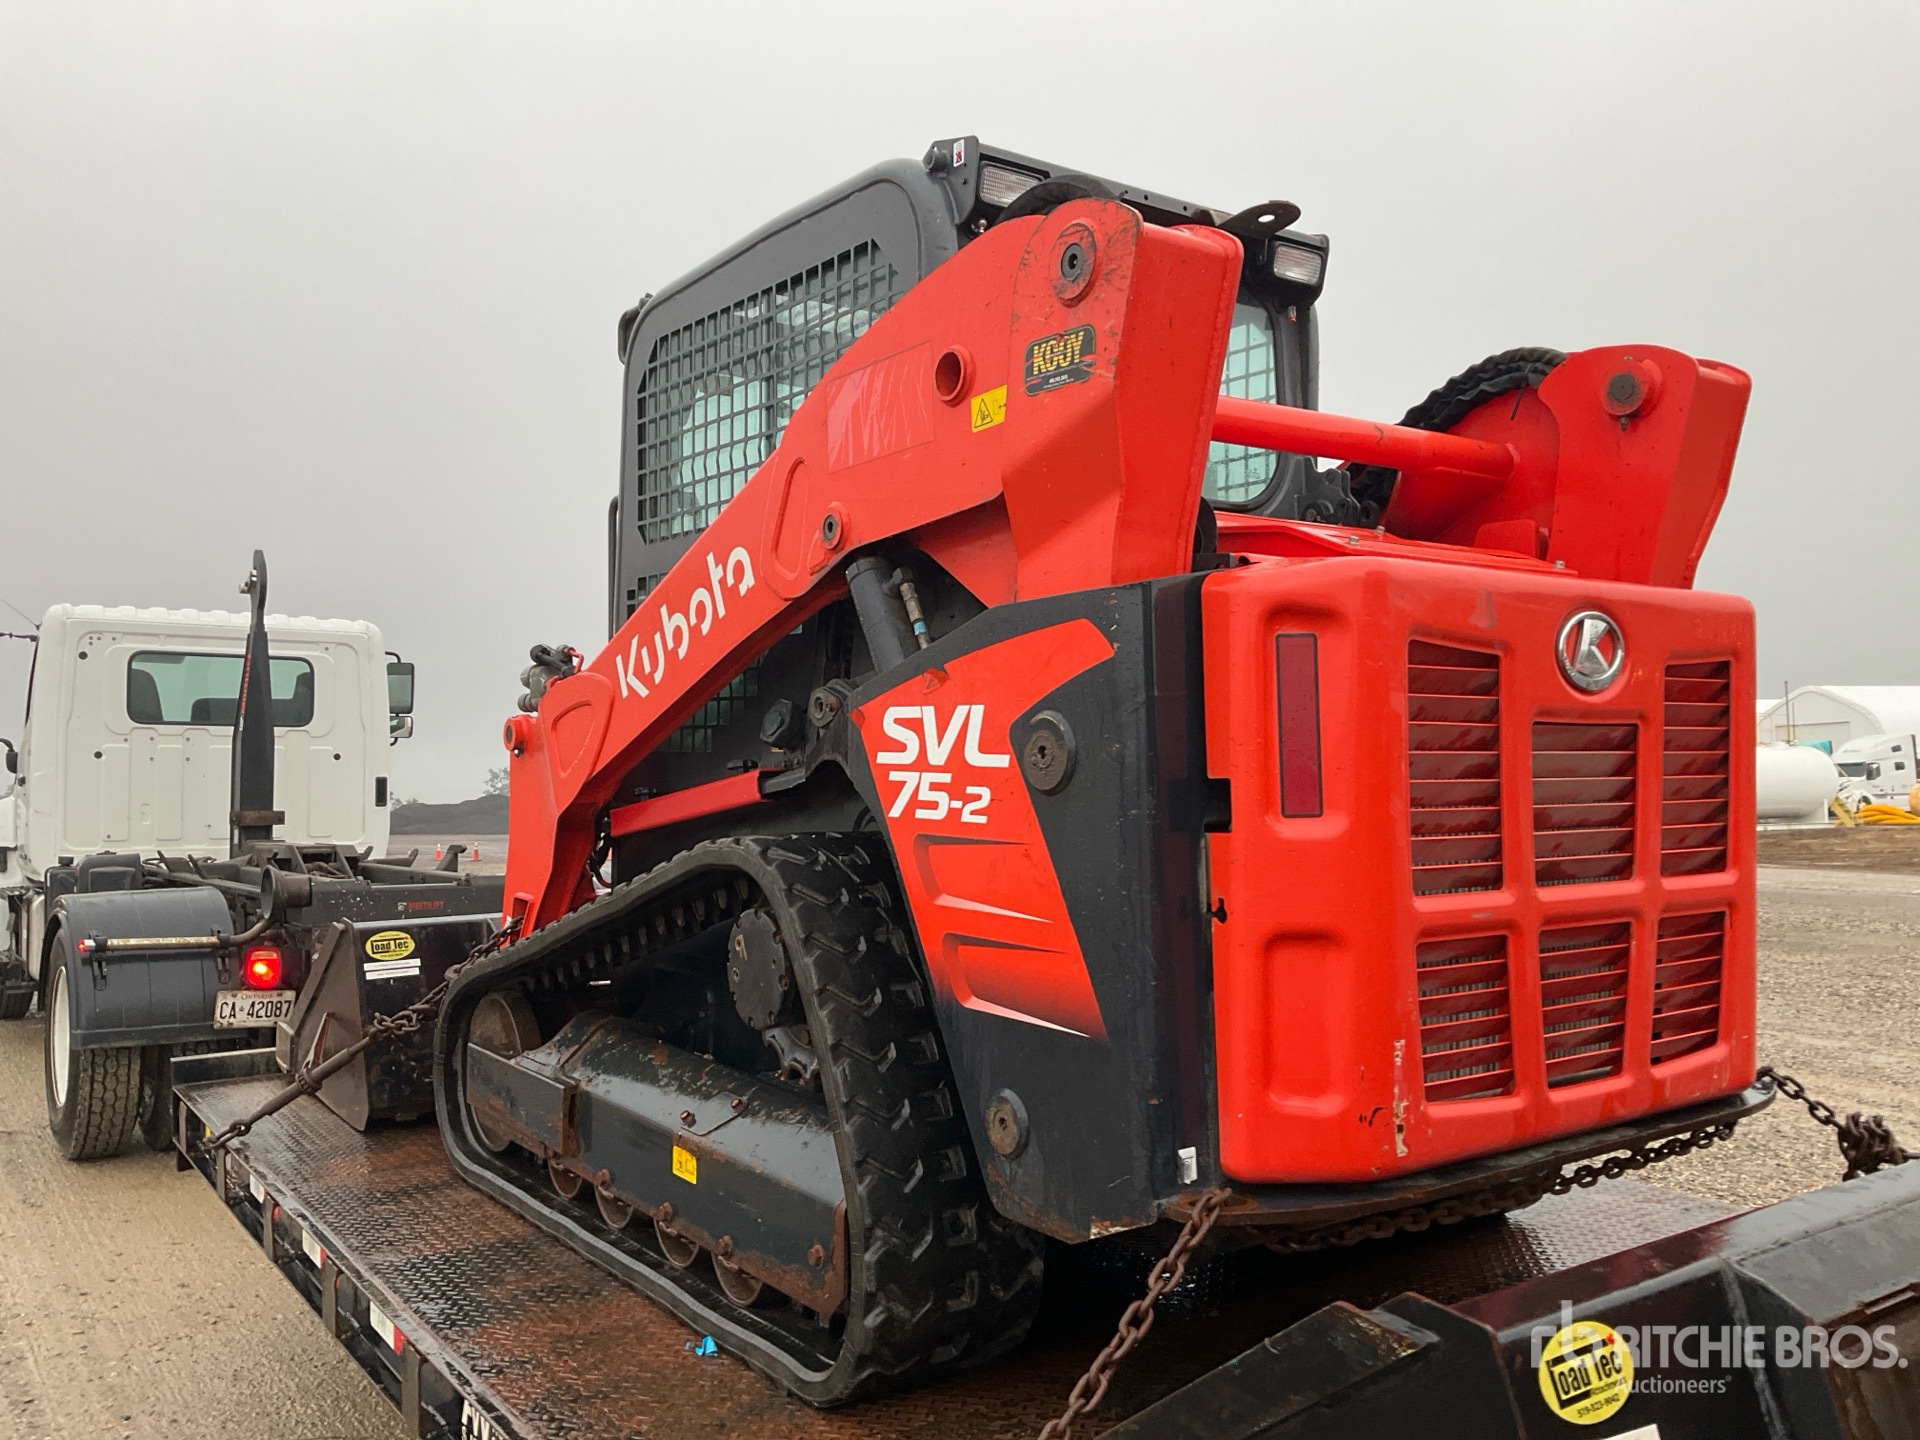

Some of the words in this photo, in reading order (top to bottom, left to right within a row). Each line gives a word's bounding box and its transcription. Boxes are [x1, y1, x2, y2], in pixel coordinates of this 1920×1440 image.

[615, 546, 755, 699] Kubota
[876, 704, 1010, 768] SVL
[888, 771, 991, 824] 75-2
[219, 1001, 236, 1019] CA
[246, 1000, 292, 1018] 42087
